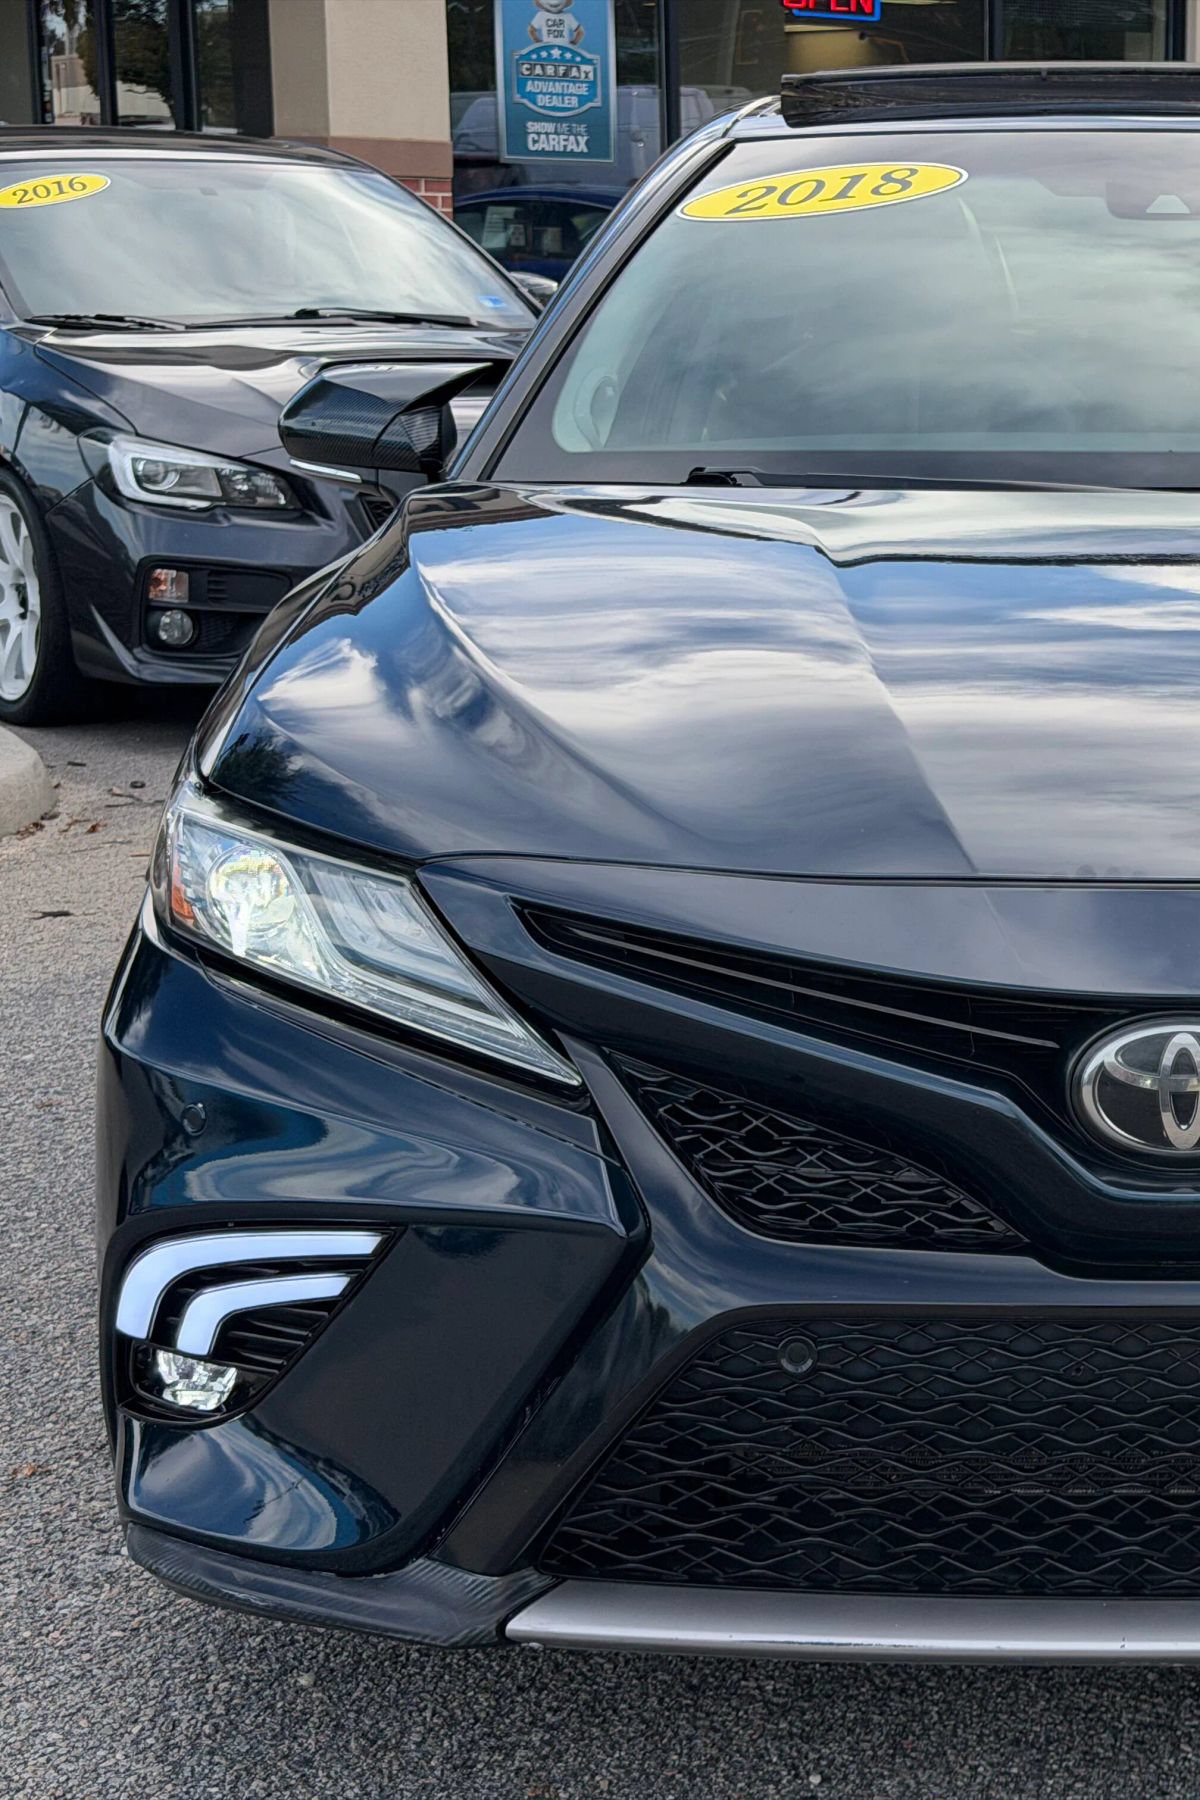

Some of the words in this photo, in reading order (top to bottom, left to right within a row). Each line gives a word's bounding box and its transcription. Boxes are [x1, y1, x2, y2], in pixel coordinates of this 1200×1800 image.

[545, 18, 566, 29] CAR
[546, 29, 566, 39] FOX
[520, 63, 592, 80] CARFAX
[526, 80, 589, 95] ADVANTAGE
[537, 94, 579, 108] DEALER
[527, 121, 556, 133] SHOW
[557, 122, 571, 134] ME
[572, 123, 588, 135] THE
[527, 134, 590, 153] CARFAX
[12, 176, 88, 204] 2016
[723, 167, 920, 216] 2018
